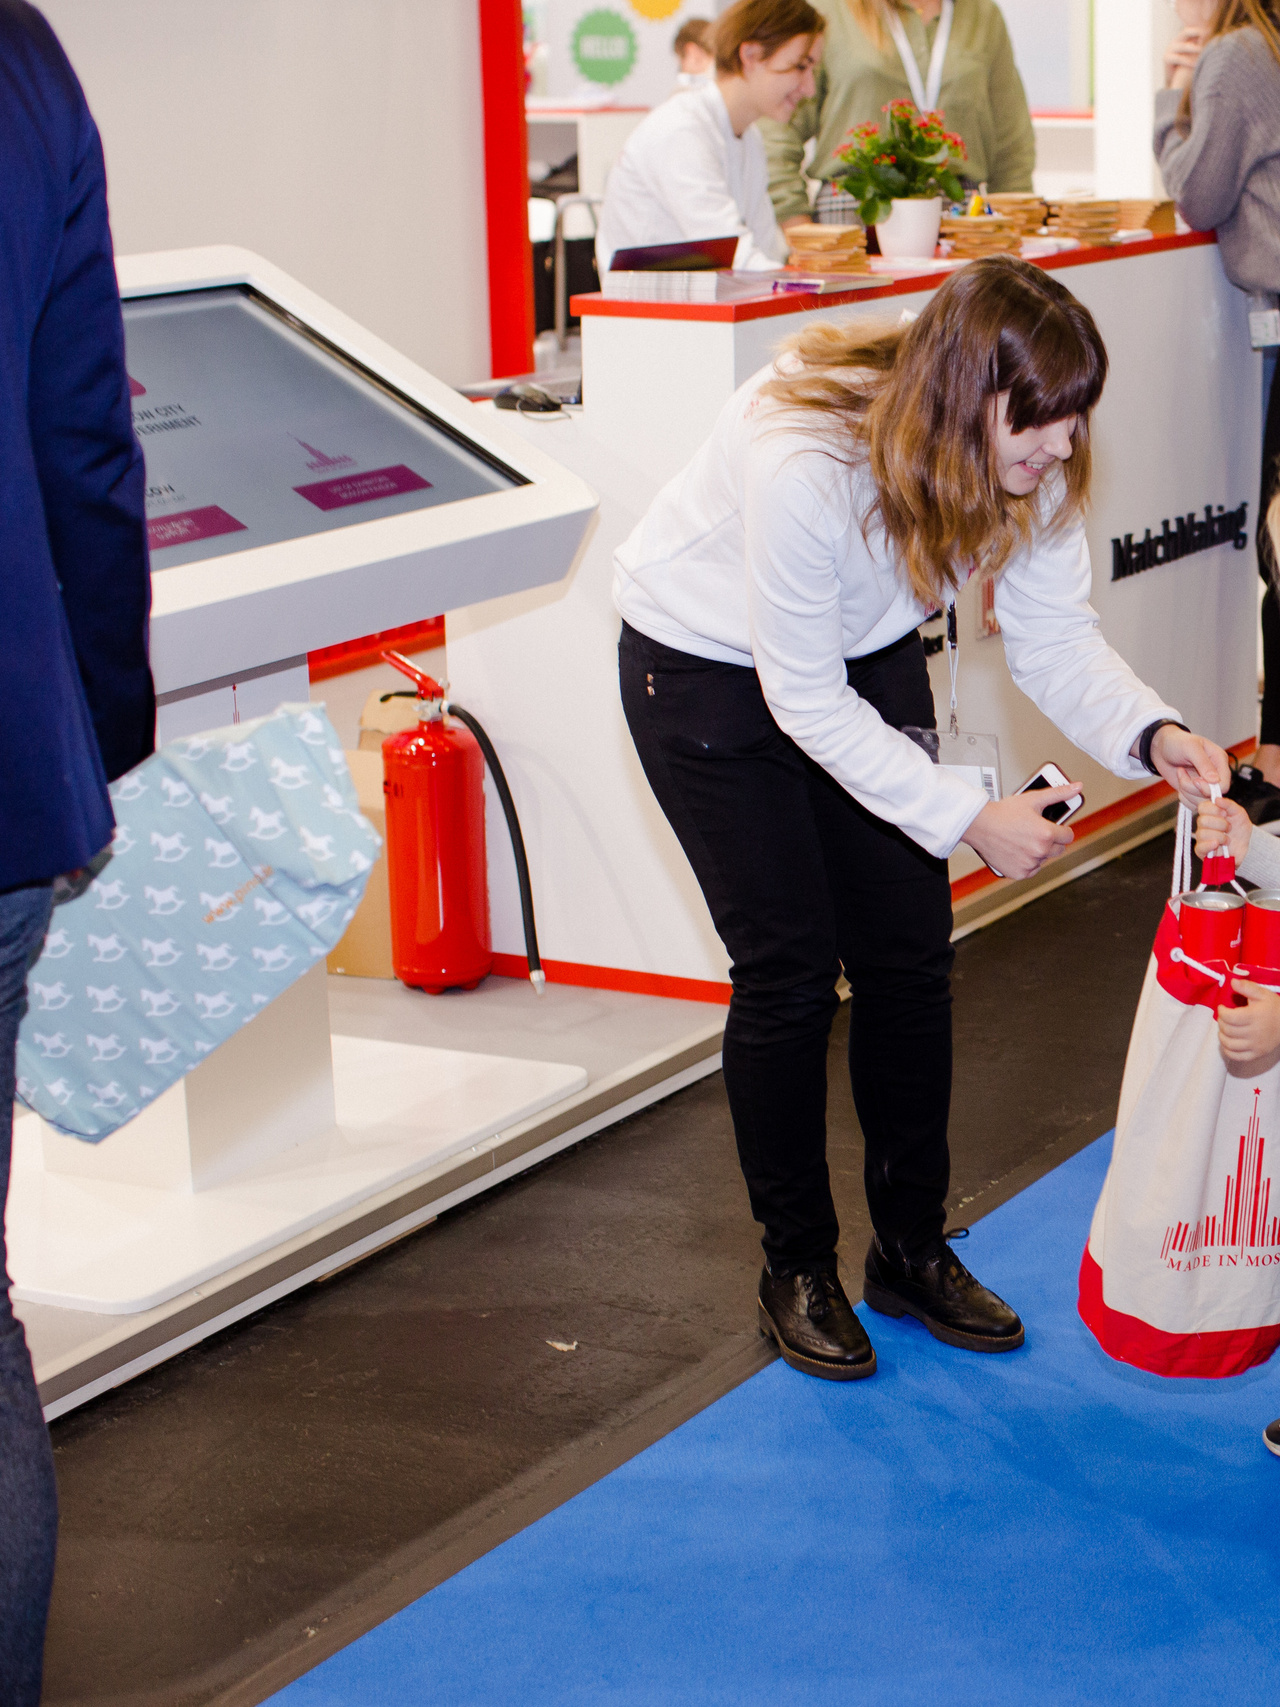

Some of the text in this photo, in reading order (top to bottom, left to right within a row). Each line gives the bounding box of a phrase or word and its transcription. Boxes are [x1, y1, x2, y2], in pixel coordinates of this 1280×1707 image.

[1111, 501, 1248, 582] MatchMaking
[1166, 1254, 1211, 1272] MADE
[1219, 1254, 1238, 1267] IN
